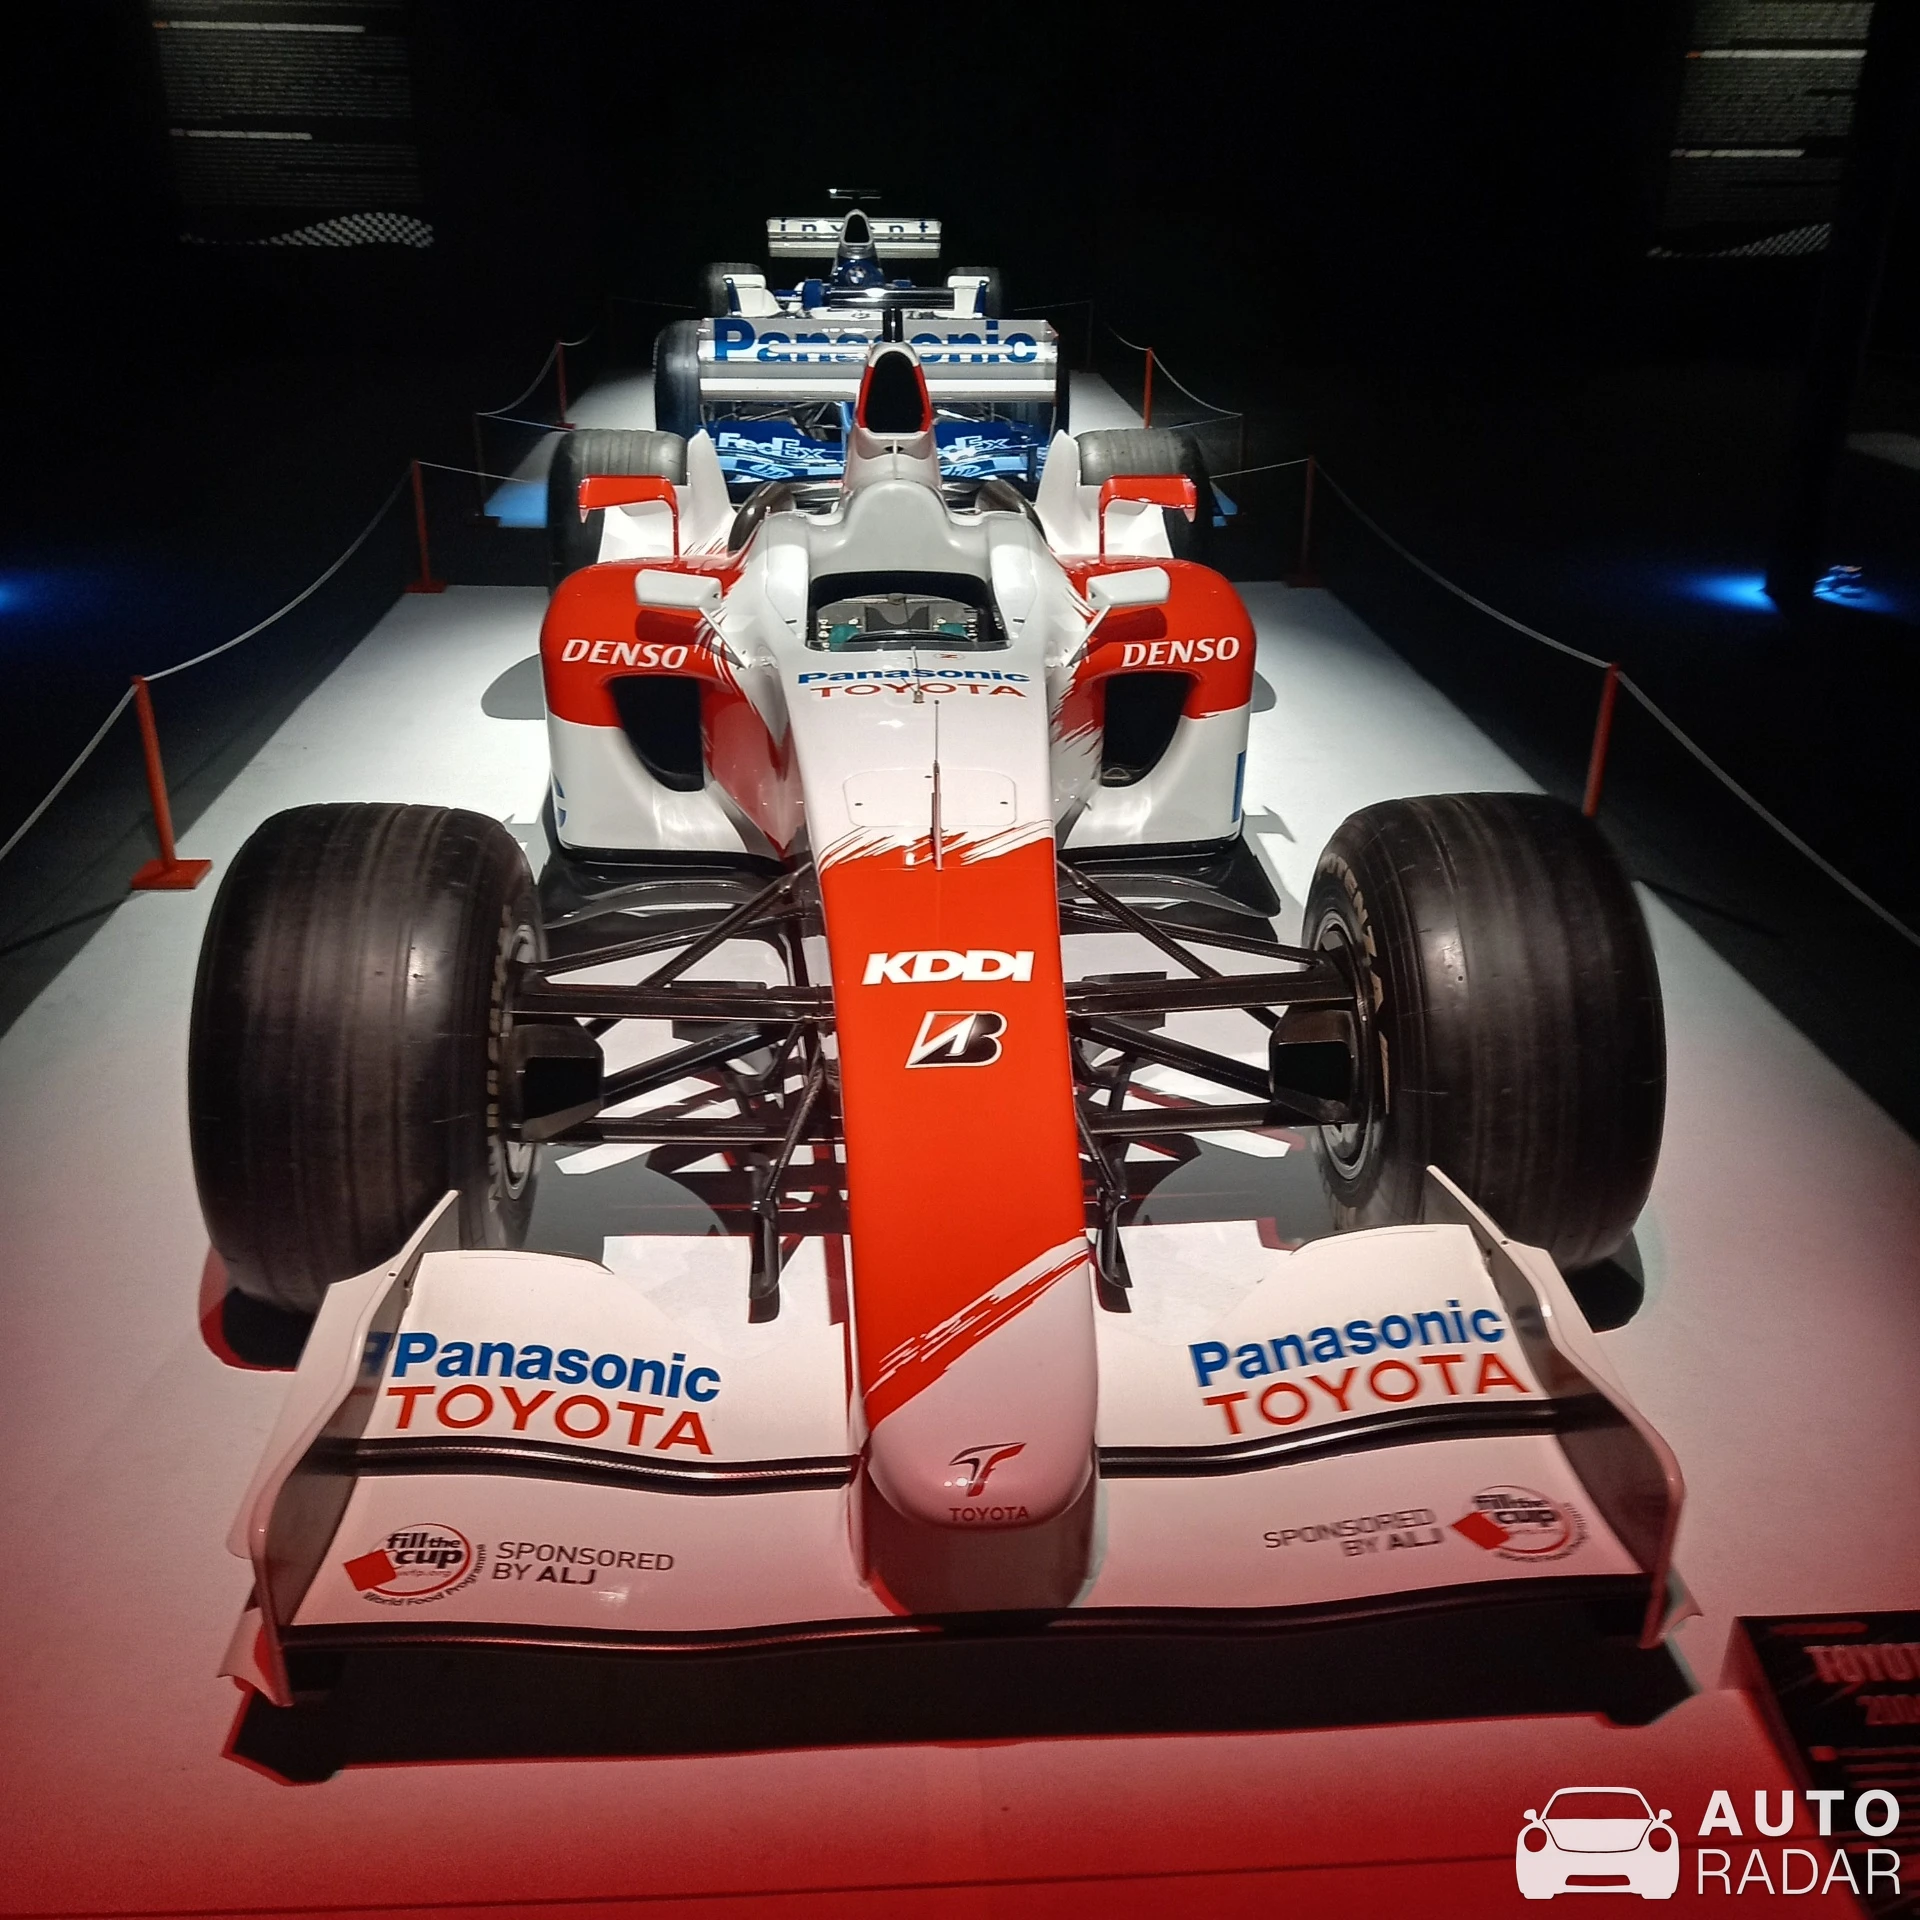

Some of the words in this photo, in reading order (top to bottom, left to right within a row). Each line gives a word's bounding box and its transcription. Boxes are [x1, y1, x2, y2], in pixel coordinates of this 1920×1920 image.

[779, 217, 930, 233] invnt
[714, 318, 1038, 363] Panaonic
[718, 432, 826, 460] FedEx
[561, 638, 690, 669] DENSO
[1121, 636, 1240, 668] DENSO
[798, 669, 1031, 684] Panasonic
[810, 683, 1028, 698] TOYOTA
[861, 950, 1035, 985] KDDI
[1188, 1299, 1505, 1387] Panasonic
[391, 1332, 722, 1402] Panasonic
[1202, 1353, 1531, 1435] TOYOTA
[387, 1384, 714, 1455] TOYOTA
[949, 1505, 1029, 1522] TOYOTA
[386, 1532, 429, 1549] fill
[429, 1537, 461, 1548] the
[395, 1550, 463, 1569] cup
[496, 1542, 675, 1571] SPONSORED
[492, 1563, 532, 1581] BY
[535, 1566, 597, 1586] ALJ
